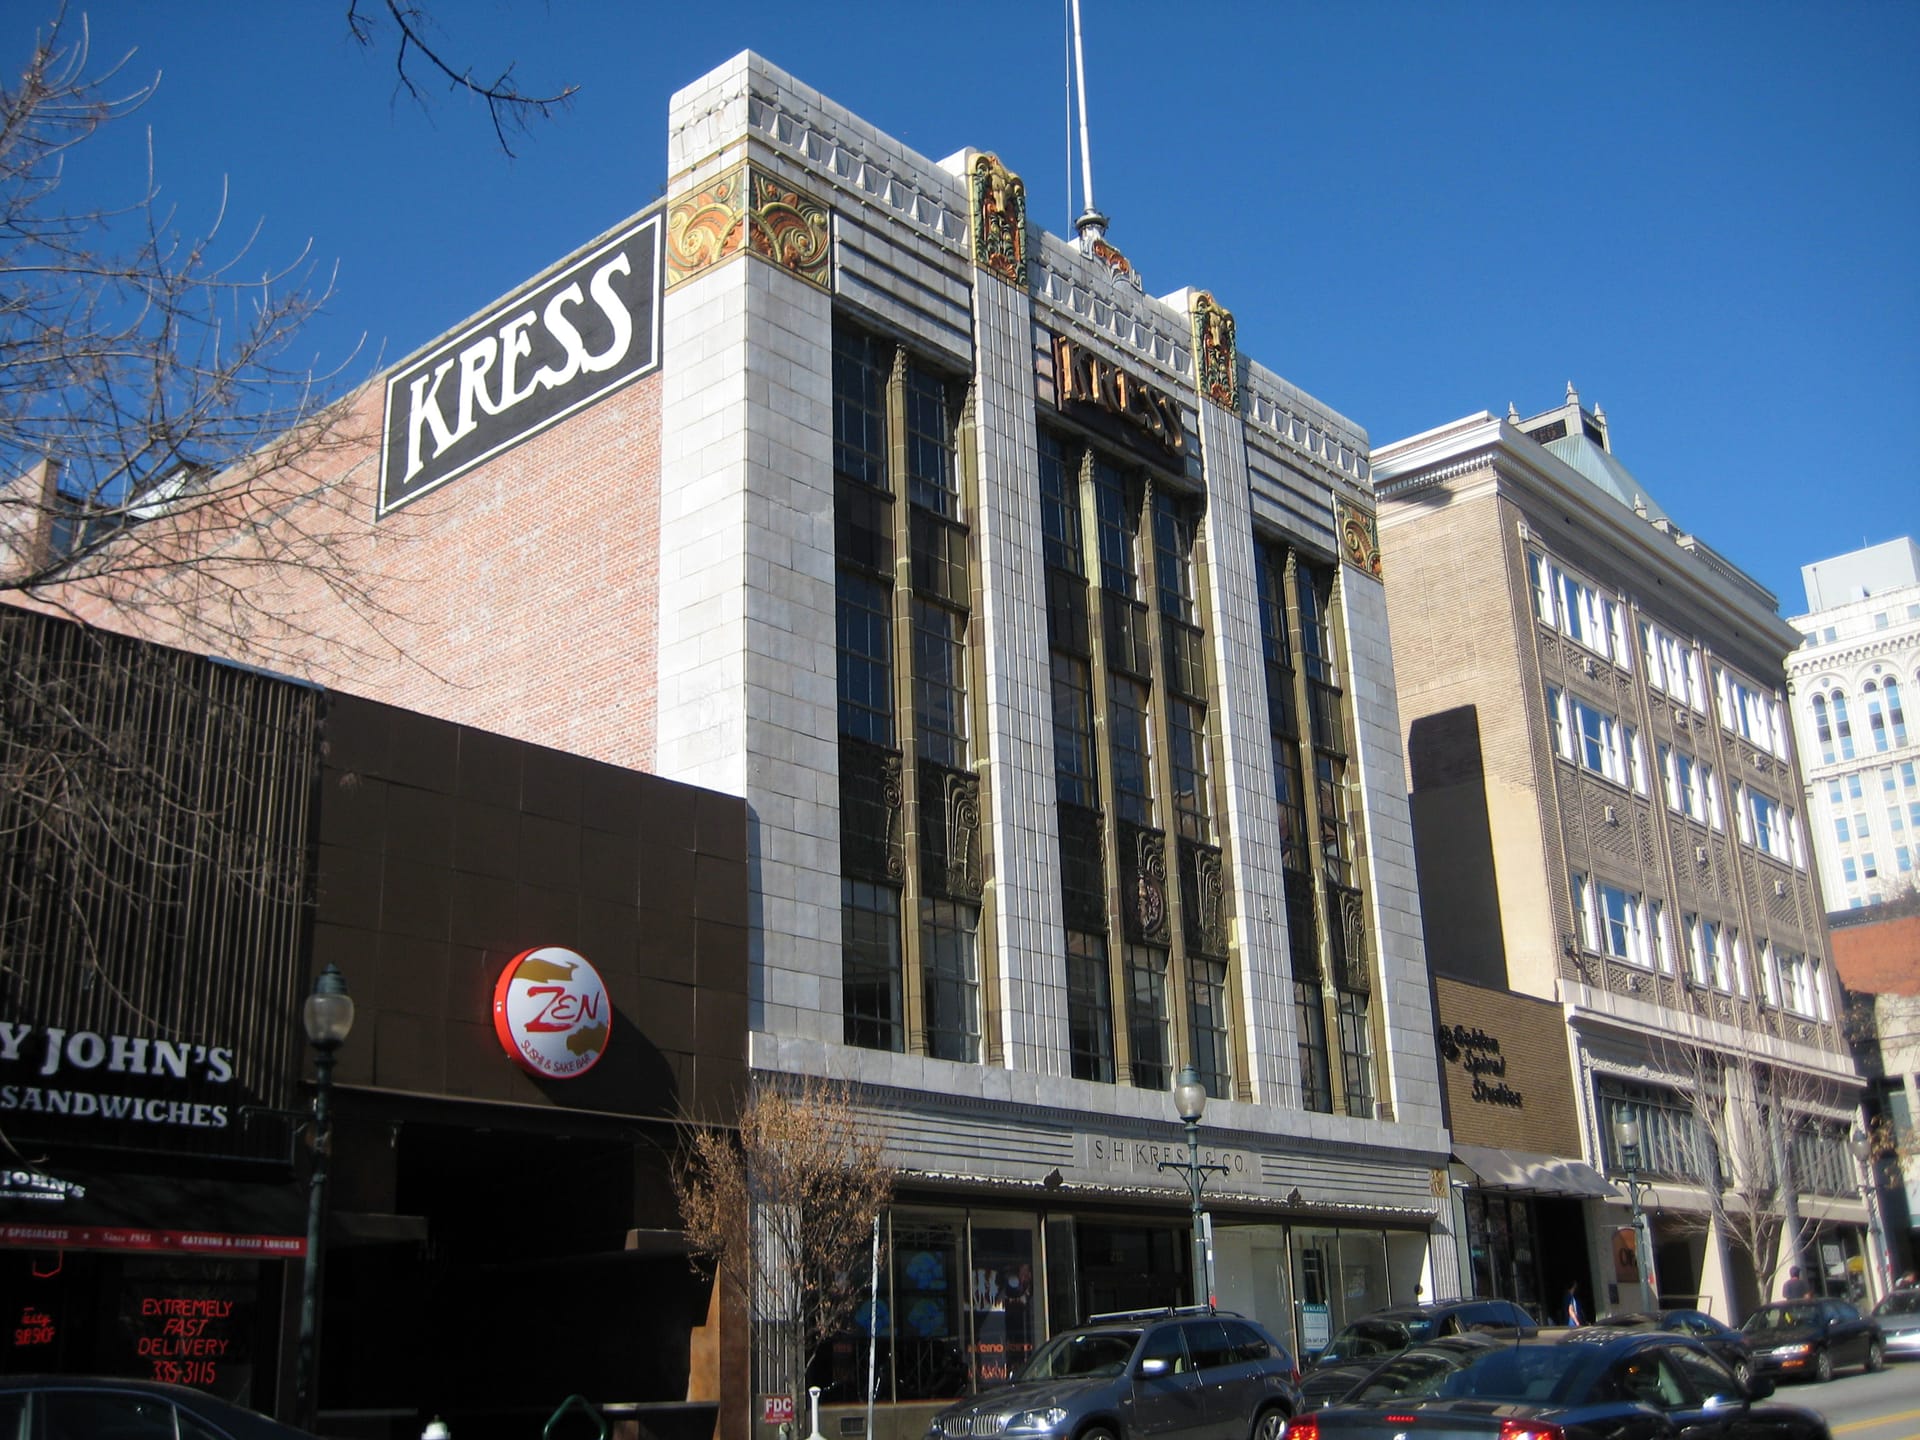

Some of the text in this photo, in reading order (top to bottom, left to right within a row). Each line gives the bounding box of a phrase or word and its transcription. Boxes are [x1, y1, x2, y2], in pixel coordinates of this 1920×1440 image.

[403, 251, 633, 485] KRESS
[524, 985, 600, 1033] ZEN
[40, 1027, 233, 1083] JOHN'S
[553, 1060, 575, 1072] SAKE
[576, 1053, 592, 1068] BAR
[0, 1085, 229, 1127] SANDWICHES
[181, 1235, 224, 1247] CATERING
[141, 1297, 234, 1318] EXTREMELY
[162, 1318, 209, 1337] FAST
[137, 1337, 230, 1357] DELIVERY
[765, 1397, 792, 1413] FDC
